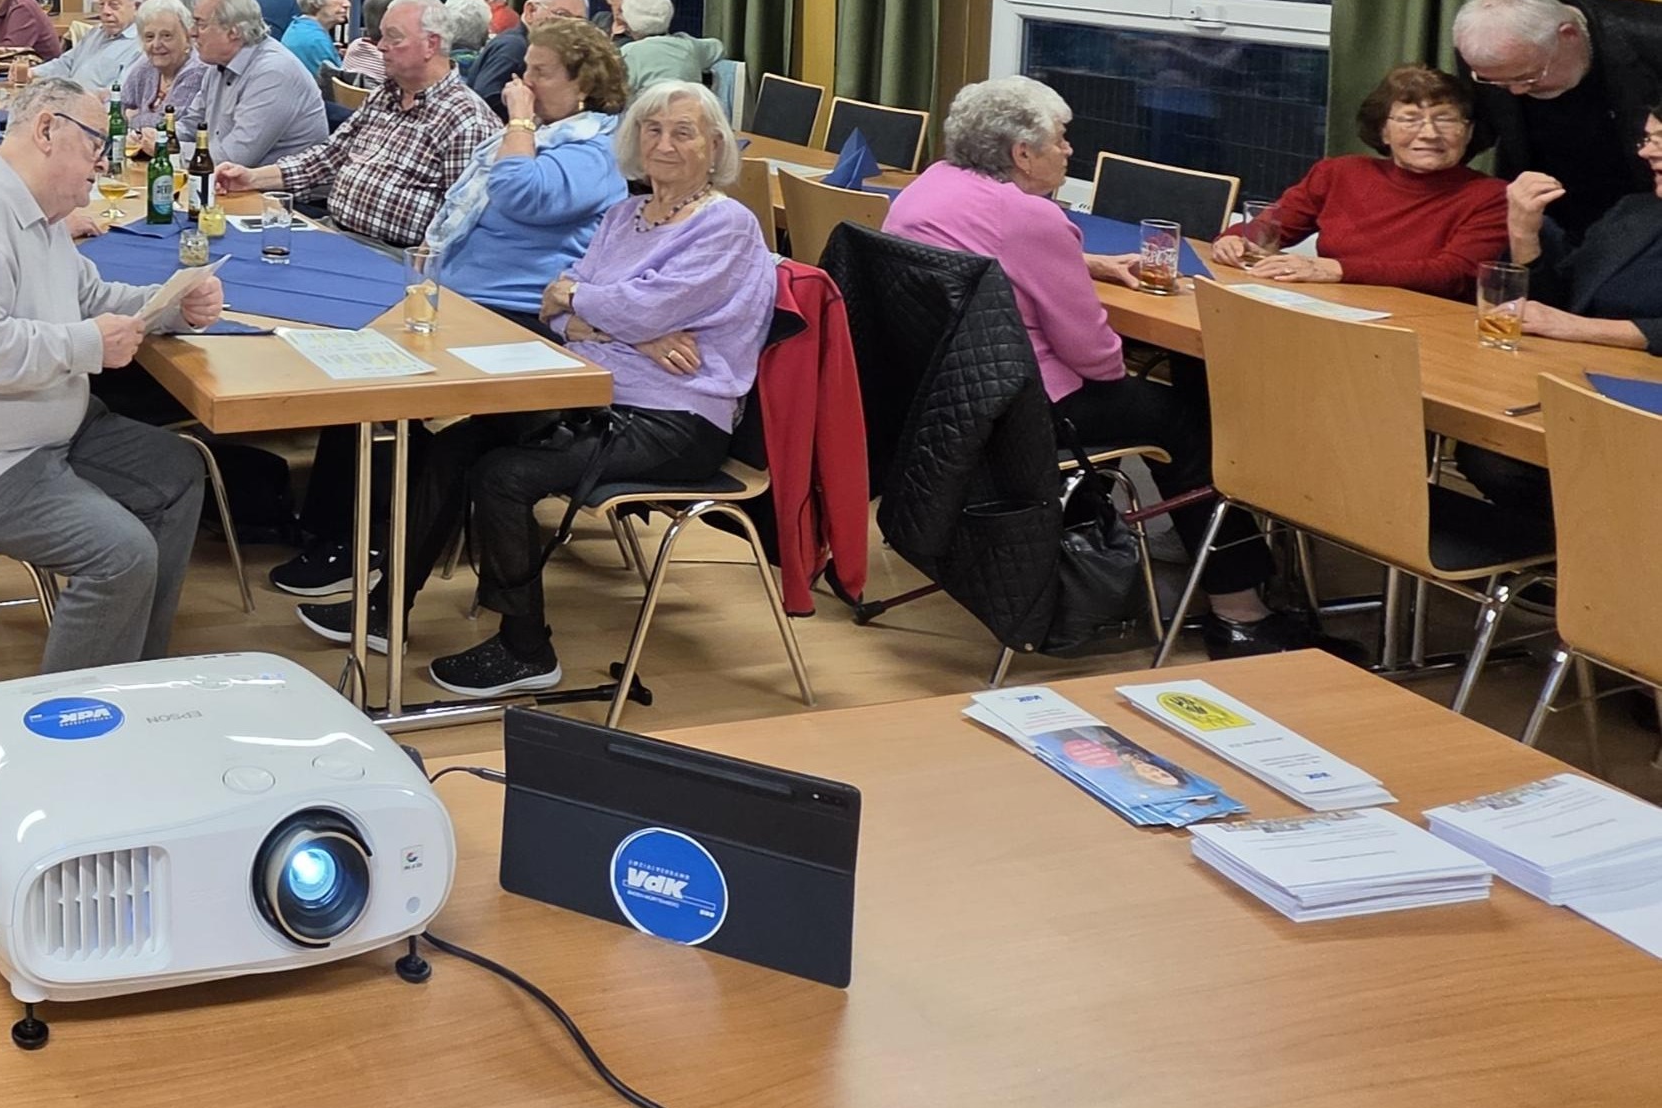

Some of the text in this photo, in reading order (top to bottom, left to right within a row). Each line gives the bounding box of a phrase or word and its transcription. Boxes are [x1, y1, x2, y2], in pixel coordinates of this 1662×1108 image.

[59, 707, 112, 724] VdK
[146, 710, 203, 725] EPSON
[627, 867, 689, 899] VdK
